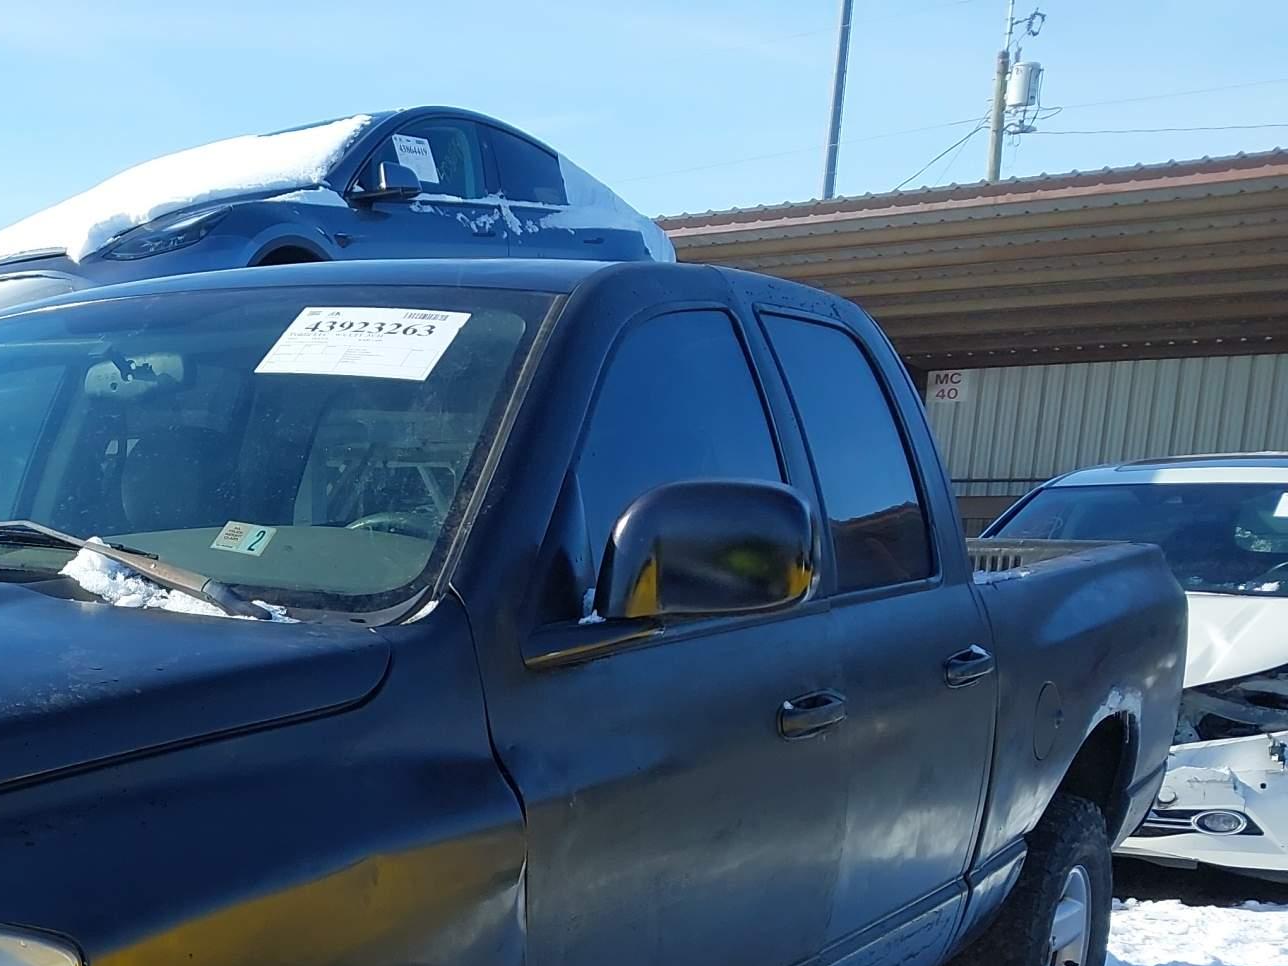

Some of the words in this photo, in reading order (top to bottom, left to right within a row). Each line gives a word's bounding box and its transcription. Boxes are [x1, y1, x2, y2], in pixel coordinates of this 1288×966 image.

[303, 319, 438, 337] 43923263
[935, 372, 962, 385] MC
[935, 387, 959, 400] 40
[247, 530, 266, 551] 2
